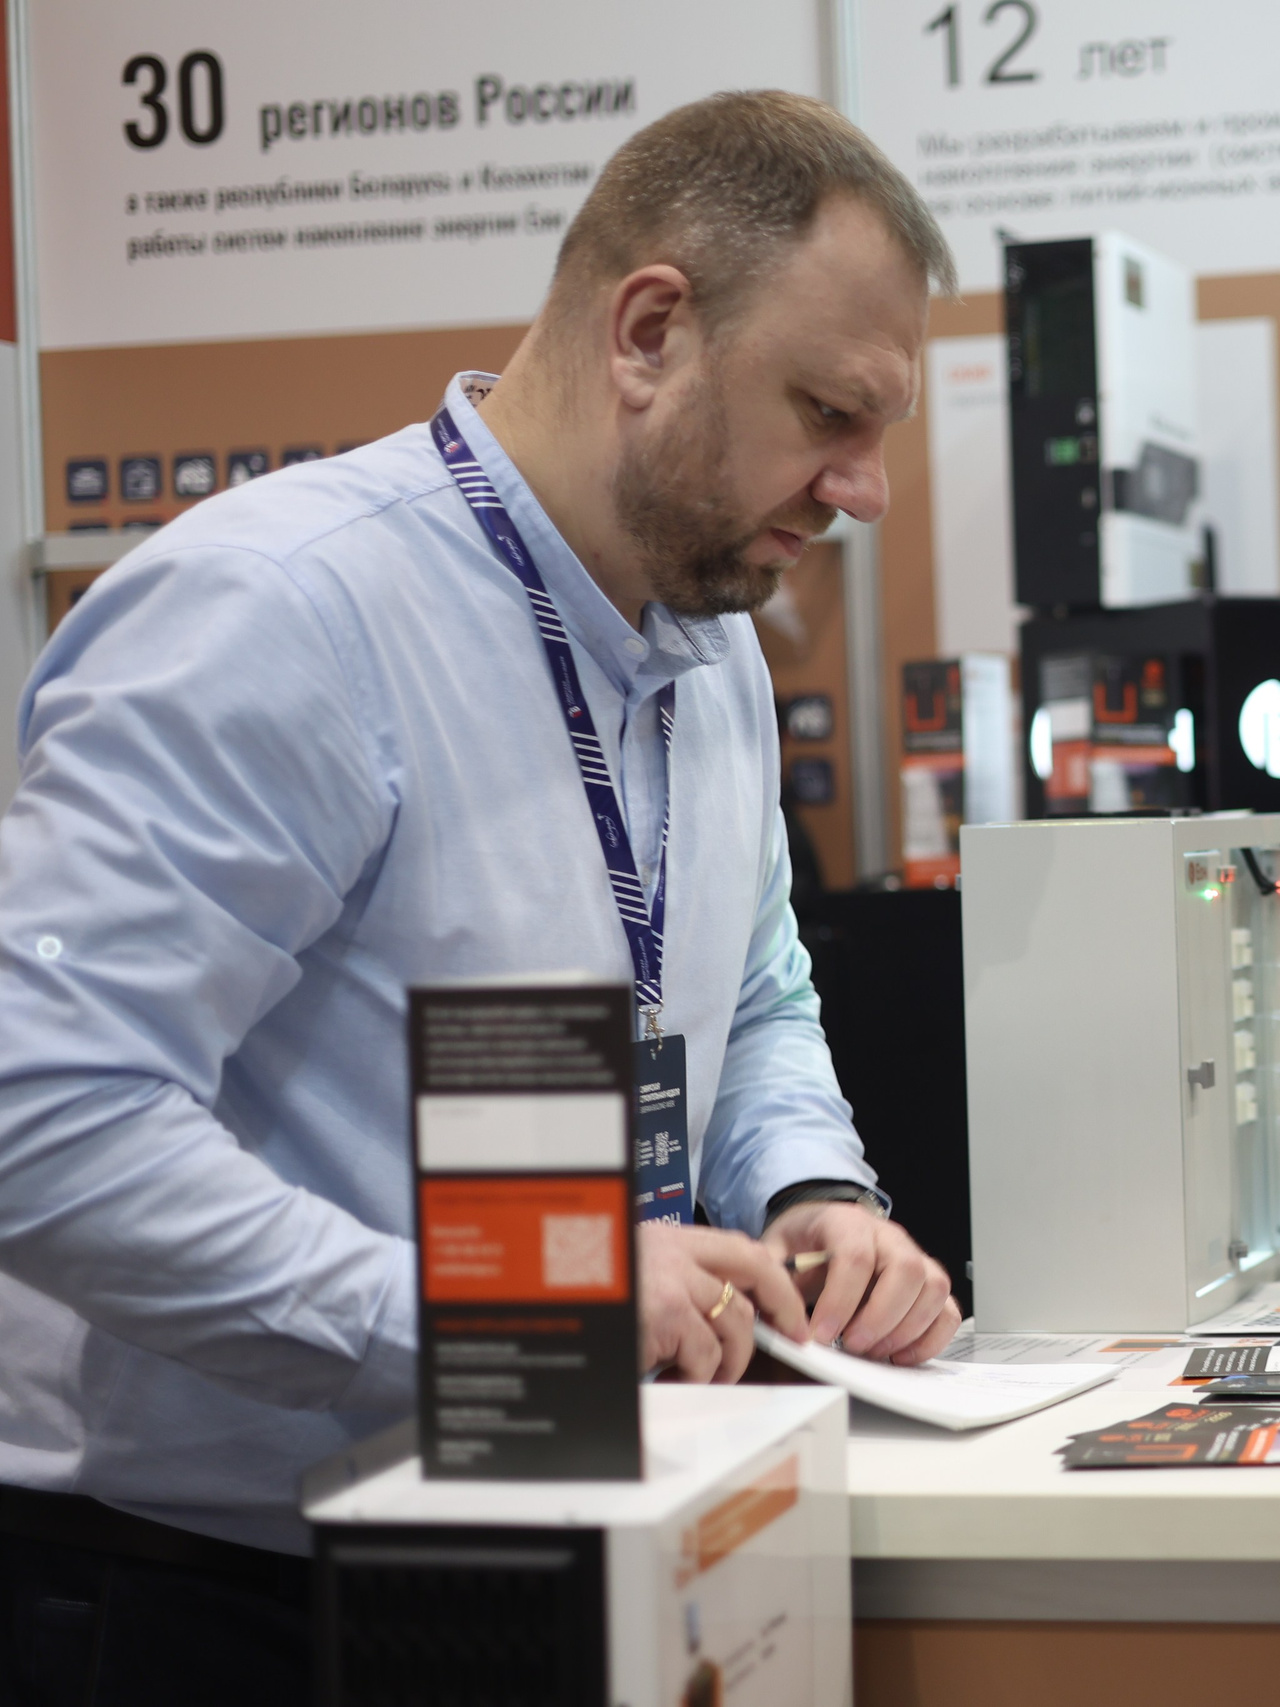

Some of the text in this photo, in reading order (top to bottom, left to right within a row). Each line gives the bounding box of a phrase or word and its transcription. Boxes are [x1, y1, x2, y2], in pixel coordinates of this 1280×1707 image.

[922, 0, 1174, 89] 12 лет
[121, 49, 637, 153] 30 регионов России
[144, 186, 208, 214] также
[126, 229, 206, 266] работы
[211, 225, 287, 254] систем
